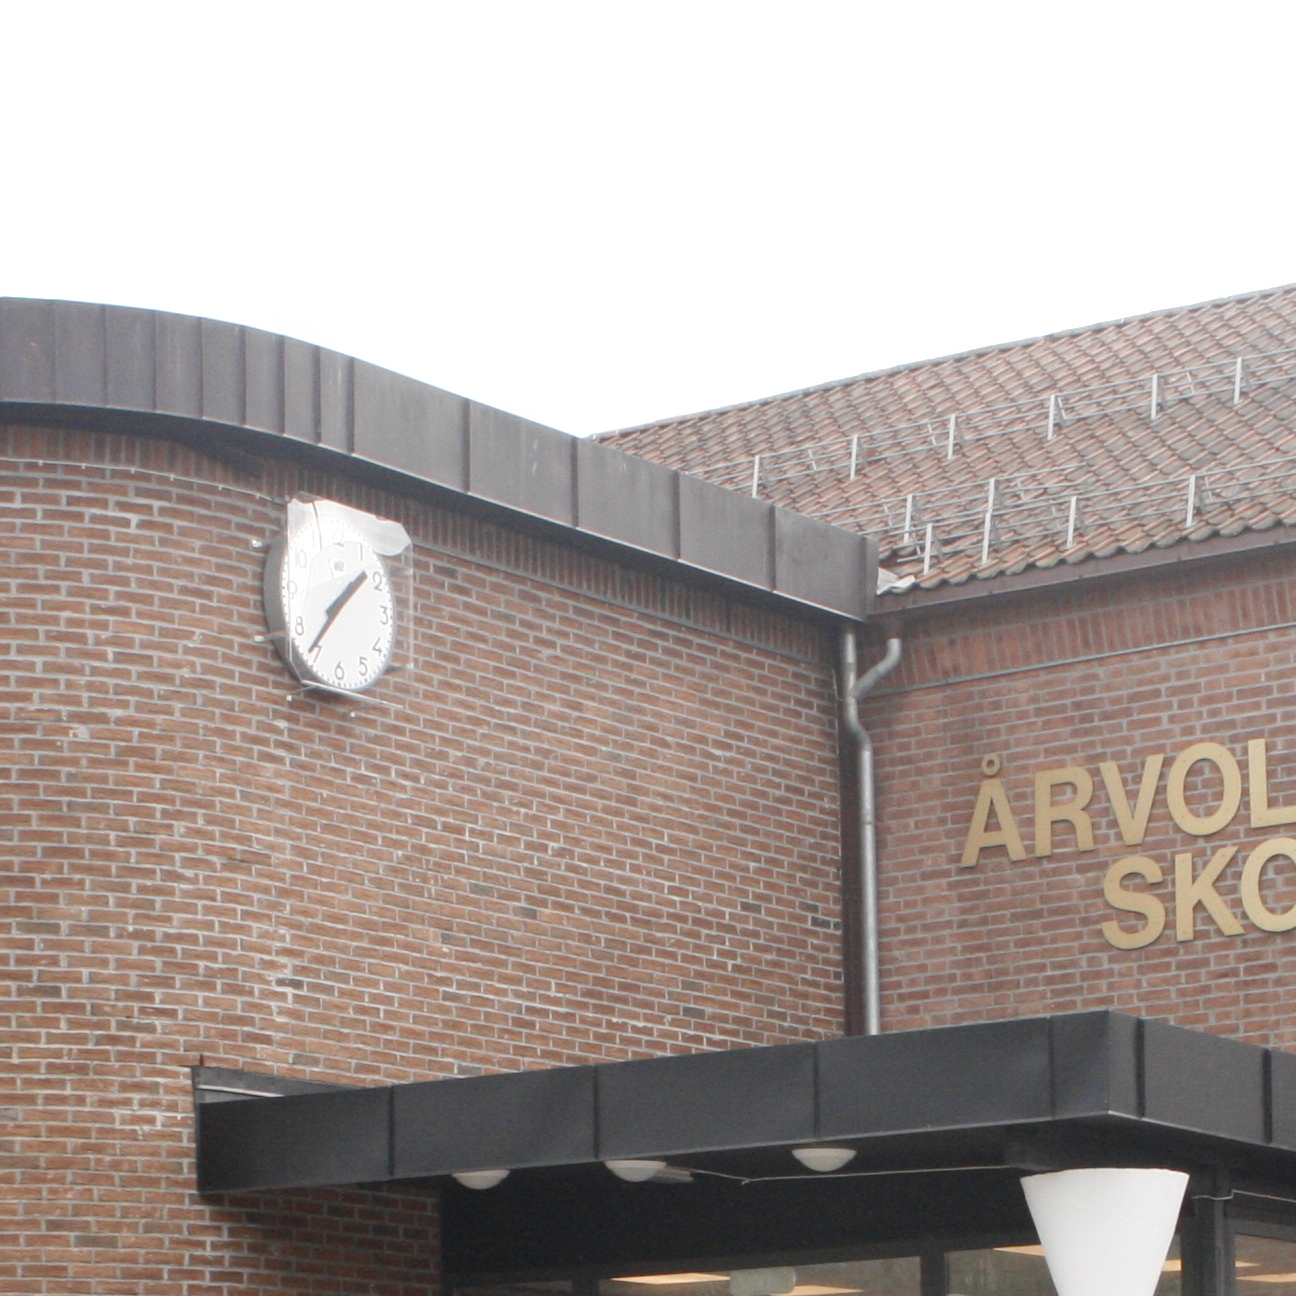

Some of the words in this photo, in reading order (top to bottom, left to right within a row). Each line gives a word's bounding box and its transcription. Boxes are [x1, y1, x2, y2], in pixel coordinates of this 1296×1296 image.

[294, 547, 308, 569] 10
[359, 543, 364, 561] 1
[372, 571, 383, 592] 2
[379, 605, 389, 625] 3
[294, 616, 304, 636] 8
[312, 645, 322, 663] 7
[372, 637, 382, 657] 4
[334, 661, 345, 680] 6
[358, 657, 368, 676] 5
